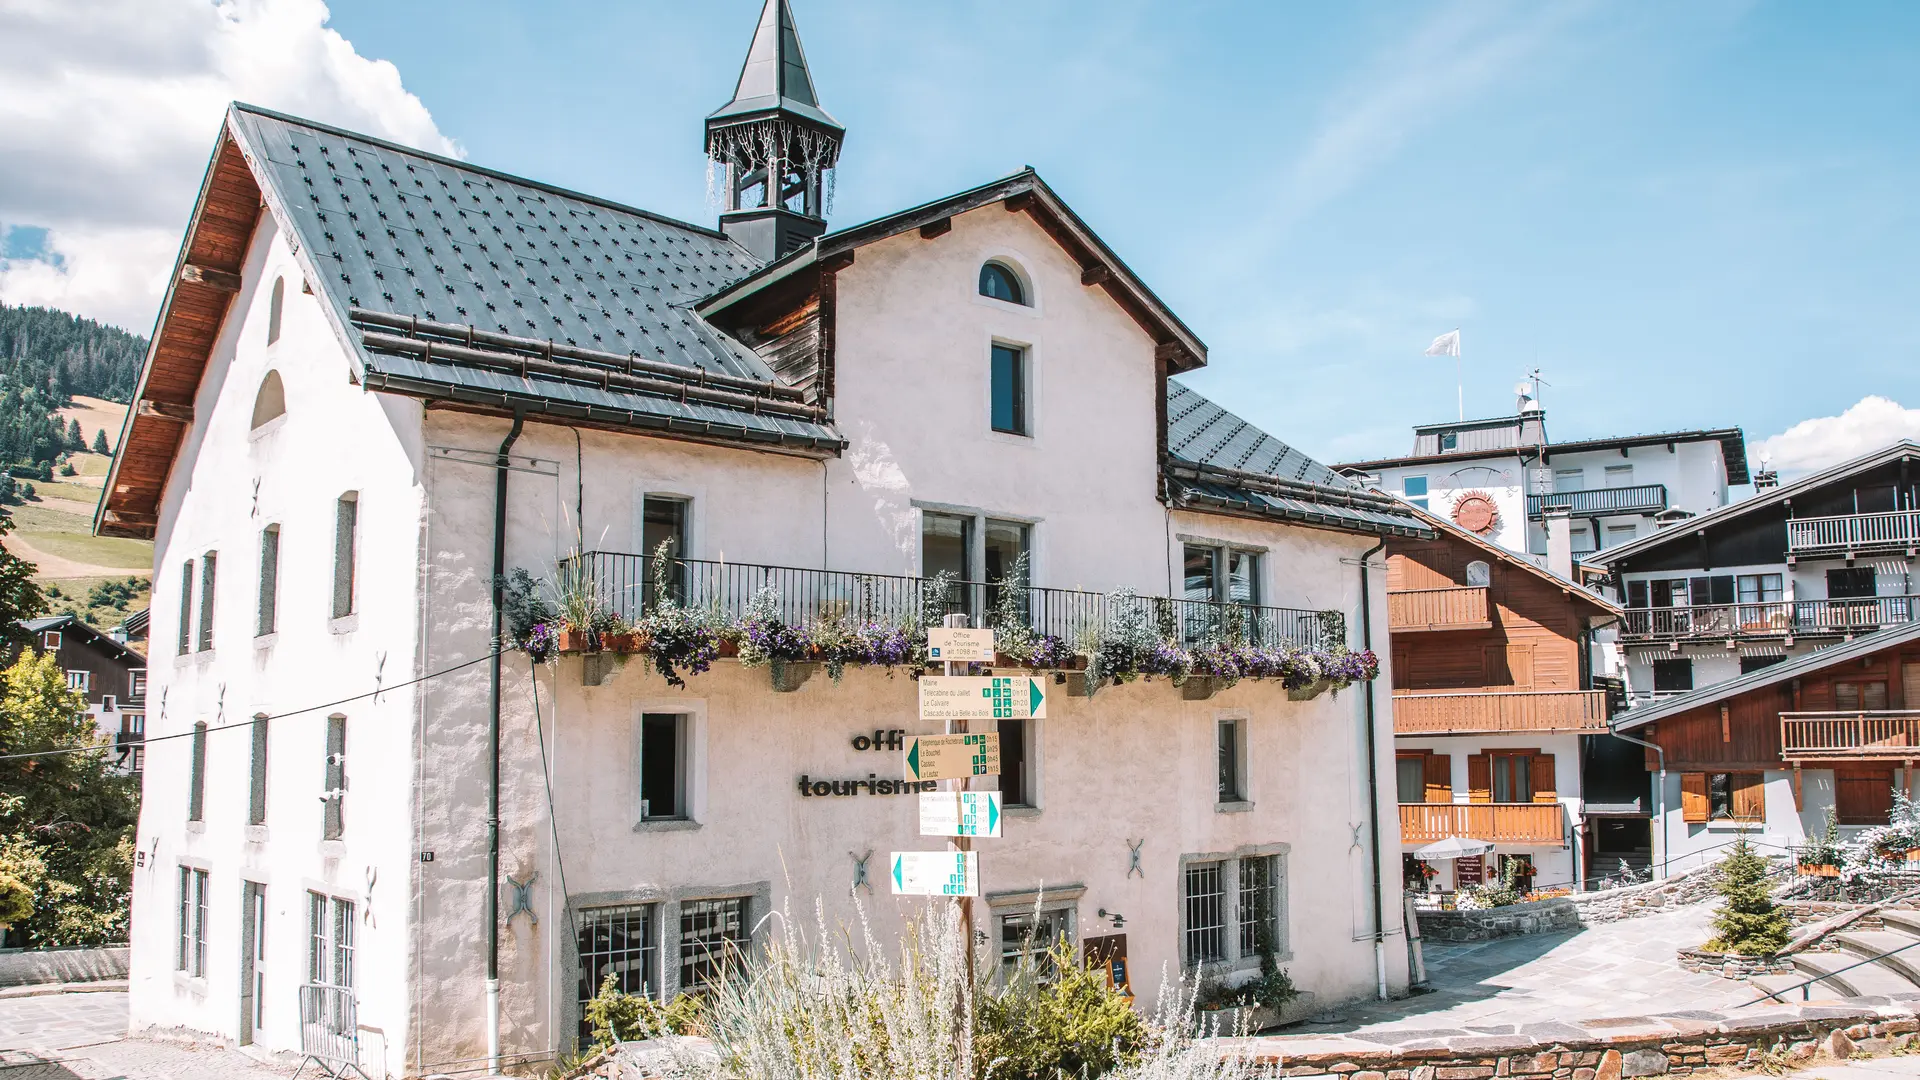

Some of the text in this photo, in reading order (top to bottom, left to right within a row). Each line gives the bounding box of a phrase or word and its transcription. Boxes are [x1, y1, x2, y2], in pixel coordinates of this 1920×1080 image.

[923, 699, 950, 707] Le Calvaire
[1012, 699, 1028, 707] 0h20
[923, 709, 945, 717] Cascade
[959, 709, 971, 717] Belle
[978, 709, 989, 717] Bois
[1012, 709, 1029, 717] 0h30
[852, 729, 905, 751] offi
[986, 735, 998, 743] 0h15
[920, 749, 926, 757] Le
[799, 773, 938, 796] tourisme
[422, 852, 432, 861] 70
